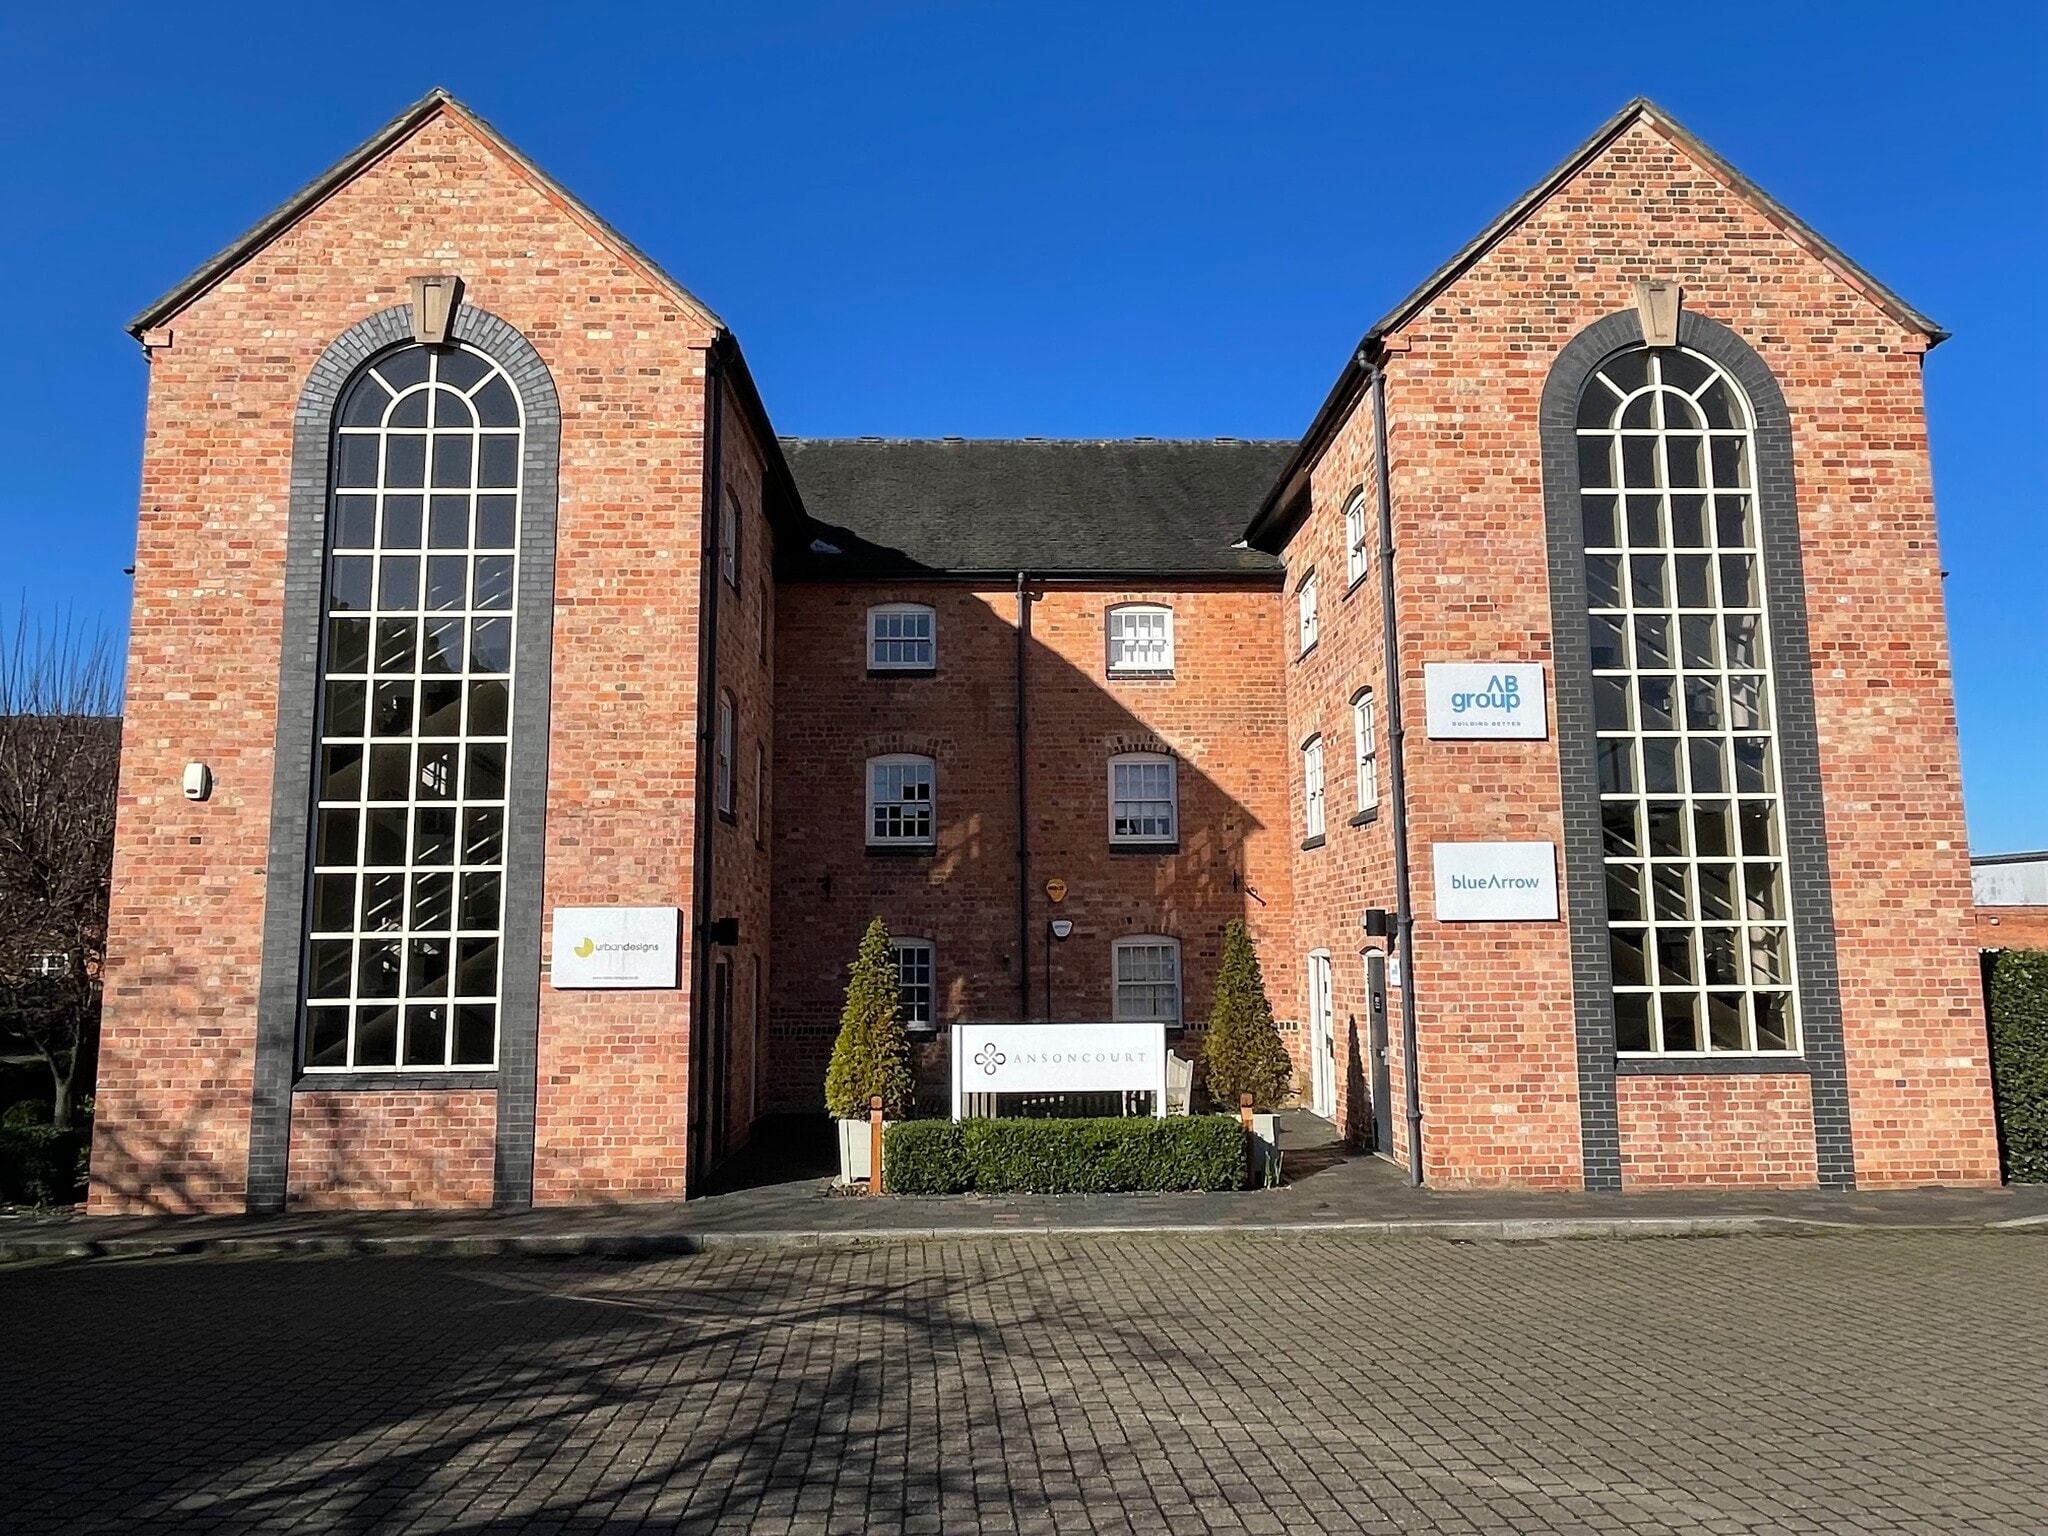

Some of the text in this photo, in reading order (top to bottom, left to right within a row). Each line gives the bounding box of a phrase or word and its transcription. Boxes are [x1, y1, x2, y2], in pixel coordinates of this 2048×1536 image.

[1486, 675, 1519, 692] AB
[1451, 693, 1521, 713] group
[1451, 874, 1540, 889] blueArrow
[595, 942, 660, 953] urbandesigns
[1013, 1052, 1147, 1064] ANSONCOURT
